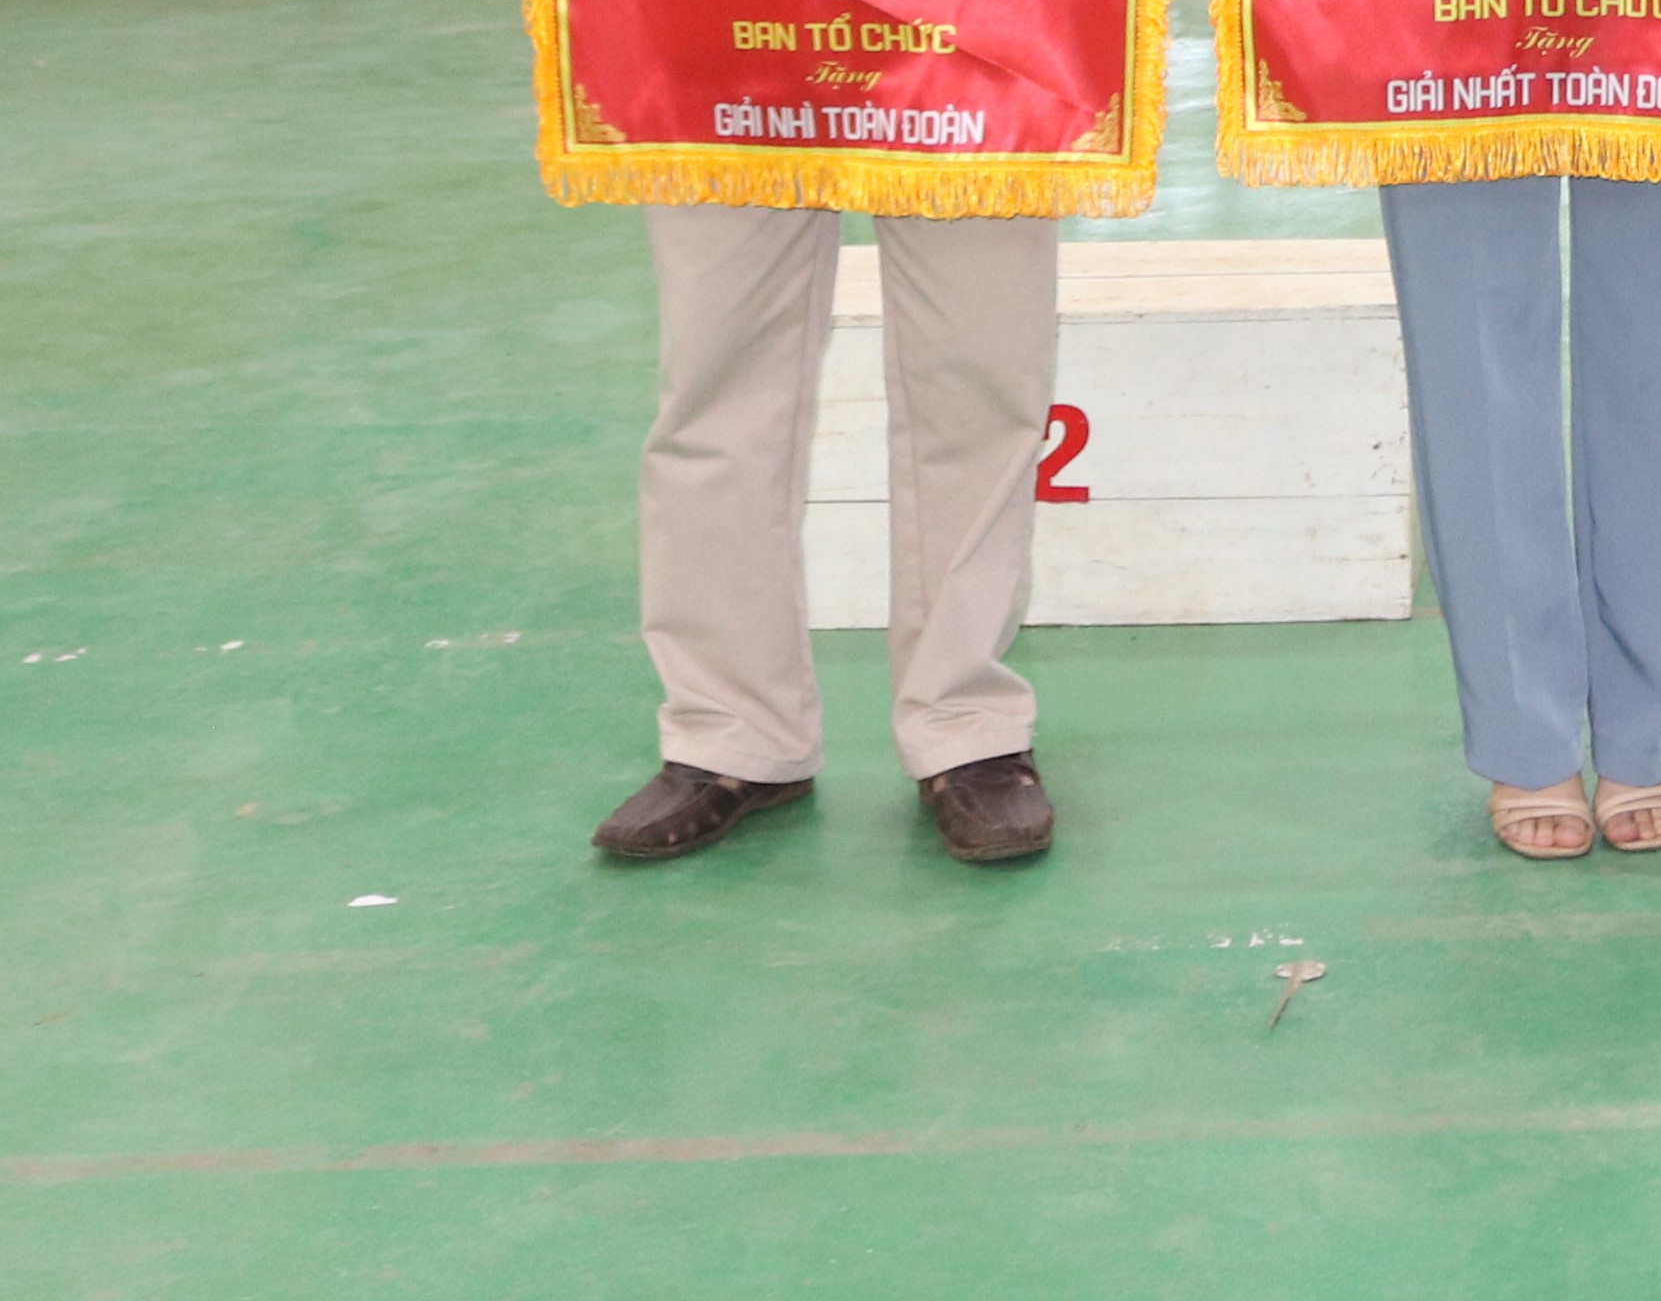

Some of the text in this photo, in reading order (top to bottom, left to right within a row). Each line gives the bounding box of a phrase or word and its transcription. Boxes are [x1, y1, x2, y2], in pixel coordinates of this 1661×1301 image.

[732, 12, 957, 54] BAN TỔ CHỨC
[1515, 26, 1595, 58] Tặng
[805, 60, 882, 92] Tặng
[1387, 70, 1445, 113] GIẢI
[1452, 64, 1536, 111] NHẤT
[1545, 66, 1630, 107] TOÀN
[714, 95, 985, 145] GIẢI NHÌ TOÀN ĐOÀN
[1034, 404, 1090, 503] 2
